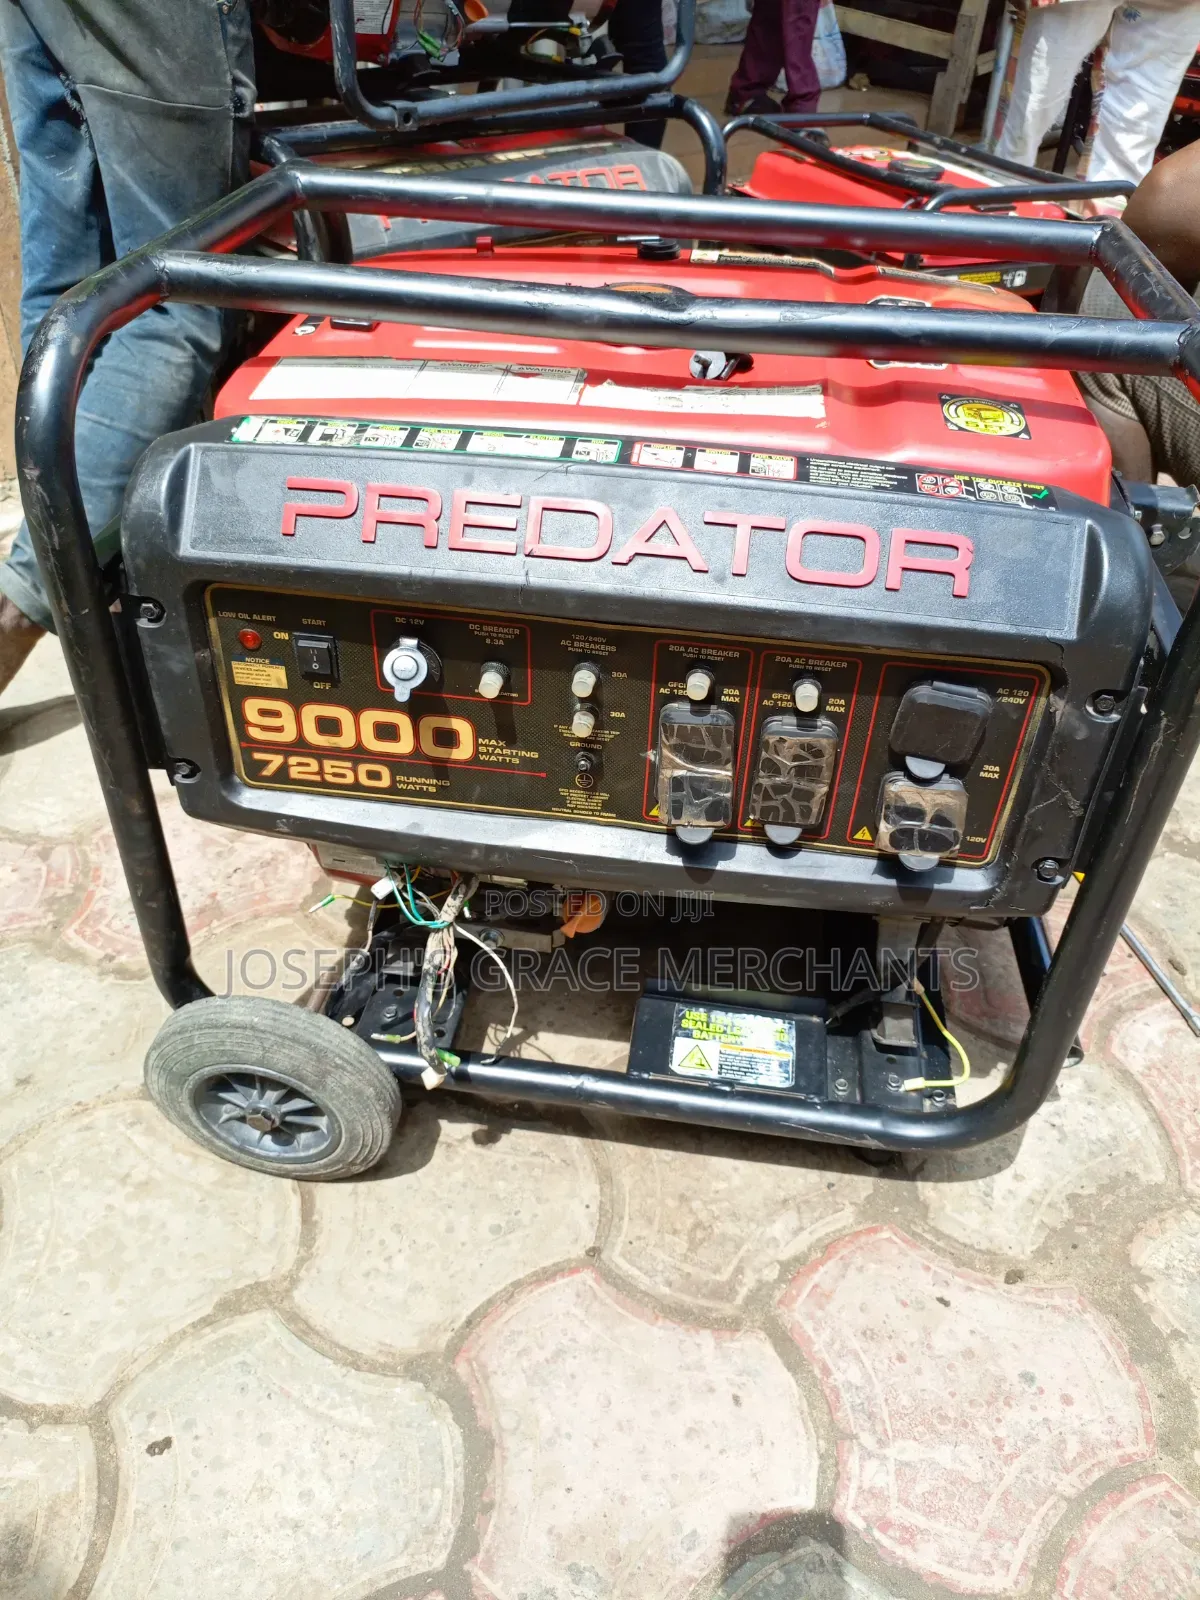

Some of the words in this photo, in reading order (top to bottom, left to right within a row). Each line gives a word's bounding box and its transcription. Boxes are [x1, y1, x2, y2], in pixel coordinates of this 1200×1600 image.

[282, 476, 974, 599] PREDATOR
[218, 611, 236, 619] LOW
[252, 613, 277, 622] ALERT
[395, 616, 406, 624] DC
[408, 618, 425, 626] 12V
[302, 618, 326, 627] START
[469, 623, 481, 632] DC
[482, 625, 520, 635] BREAKER
[273, 631, 289, 640] ON
[571, 634, 607, 643] 120/240V
[485, 638, 505, 646] 8.3A
[574, 641, 617, 652] BREAKERS
[668, 644, 685, 652] 20A
[701, 647, 740, 659] BREAKER
[774, 655, 792, 664] 20A
[794, 657, 806, 665] AC
[808, 658, 848, 669] BREAKER
[313, 682, 331, 690] OFF
[723, 688, 740, 696] 20A
[996, 687, 1010, 695] AC
[1012, 689, 1030, 697] 120
[721, 695, 740, 703] MAX
[762, 699, 774, 707] AC
[828, 698, 845, 706] 20A
[996, 696, 1026, 704] /240V
[825, 705, 845, 713] MAX
[242, 696, 476, 761] 9000
[478, 738, 506, 747] MAX
[569, 741, 603, 750] GROUND
[478, 746, 539, 759] STARTING
[478, 754, 520, 764] WATTS
[252, 752, 393, 789] 7250
[983, 764, 1000, 772] 30A
[979, 771, 1000, 779] MAX
[396, 775, 450, 786] RUNNING
[396, 783, 437, 793] WATTS
[965, 835, 987, 843] 120V
[685, 1011, 708, 1021] USE
[681, 1019, 724, 1033] SEALED
